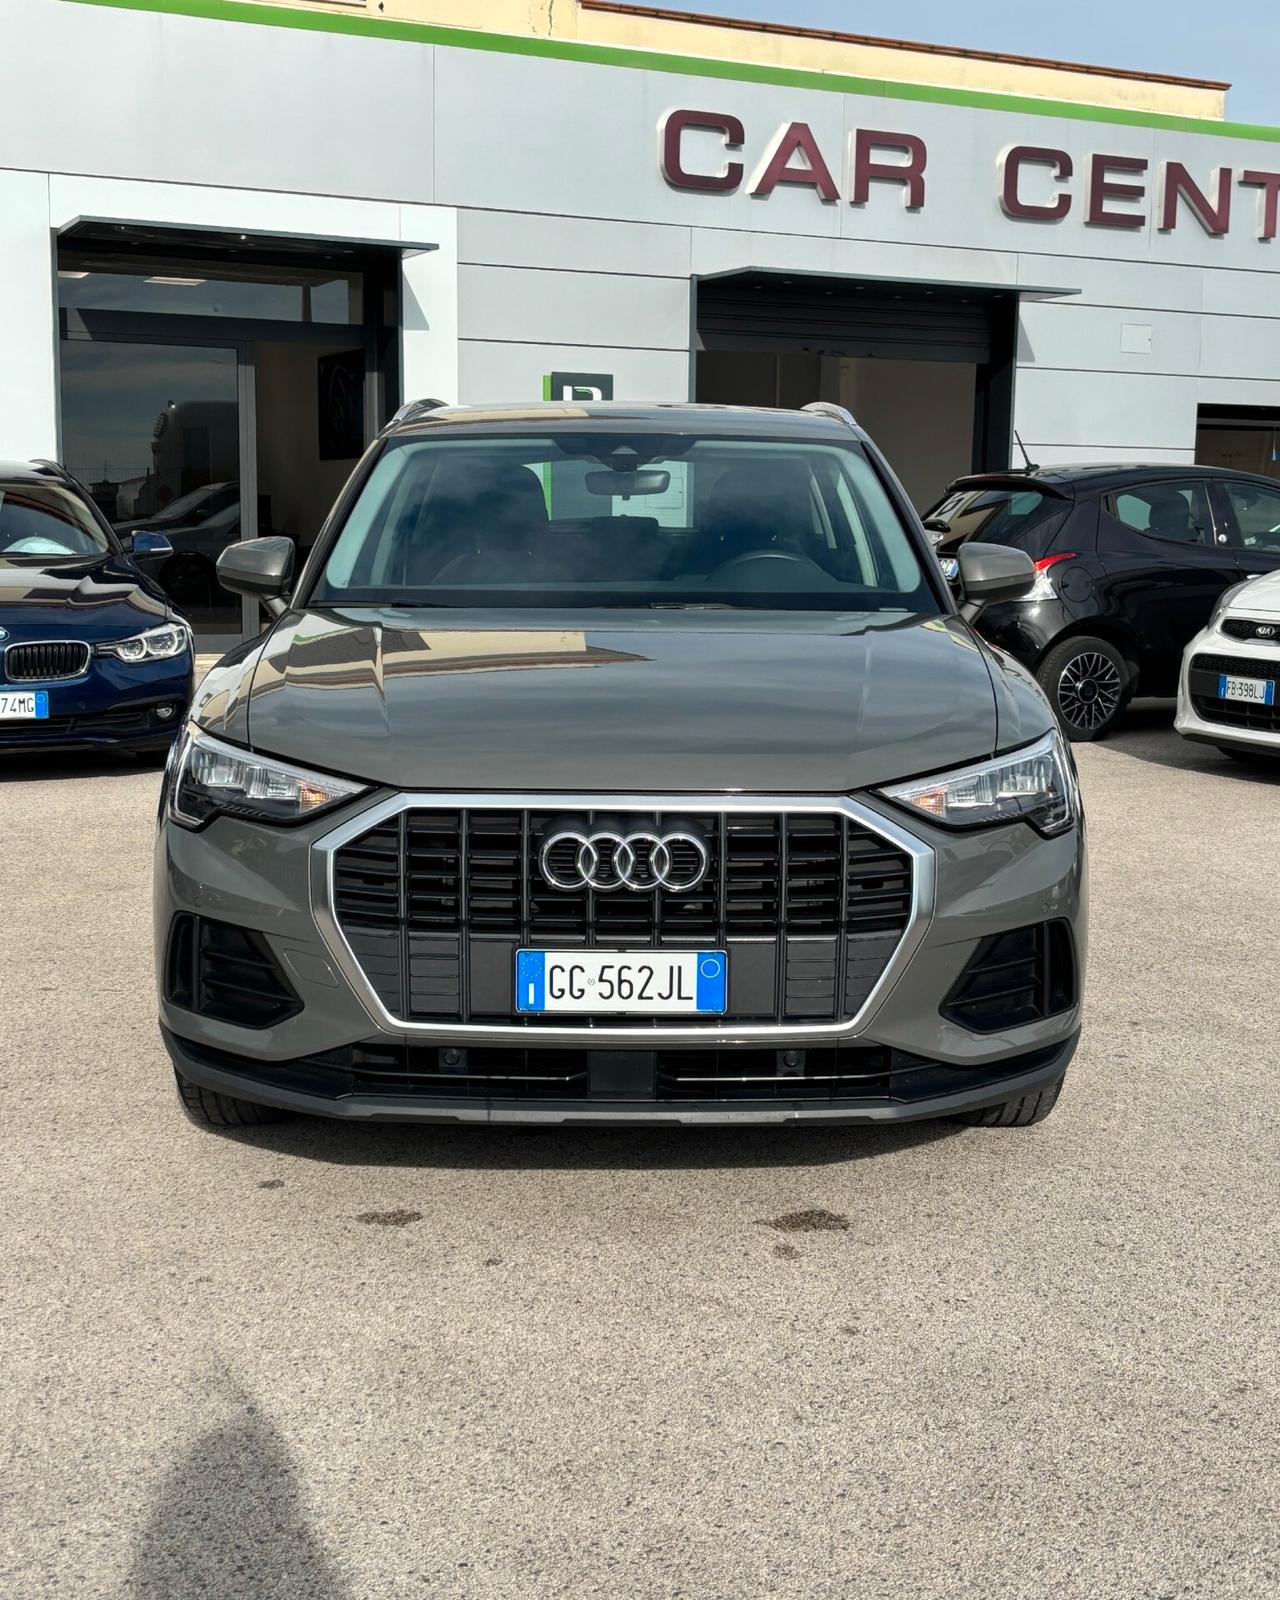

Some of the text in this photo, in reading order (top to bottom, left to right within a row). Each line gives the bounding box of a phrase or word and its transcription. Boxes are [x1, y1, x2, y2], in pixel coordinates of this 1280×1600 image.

[660, 109, 1280, 240] CAR CENT
[549, 965, 585, 999] GG
[598, 965, 693, 1000] 562JL
